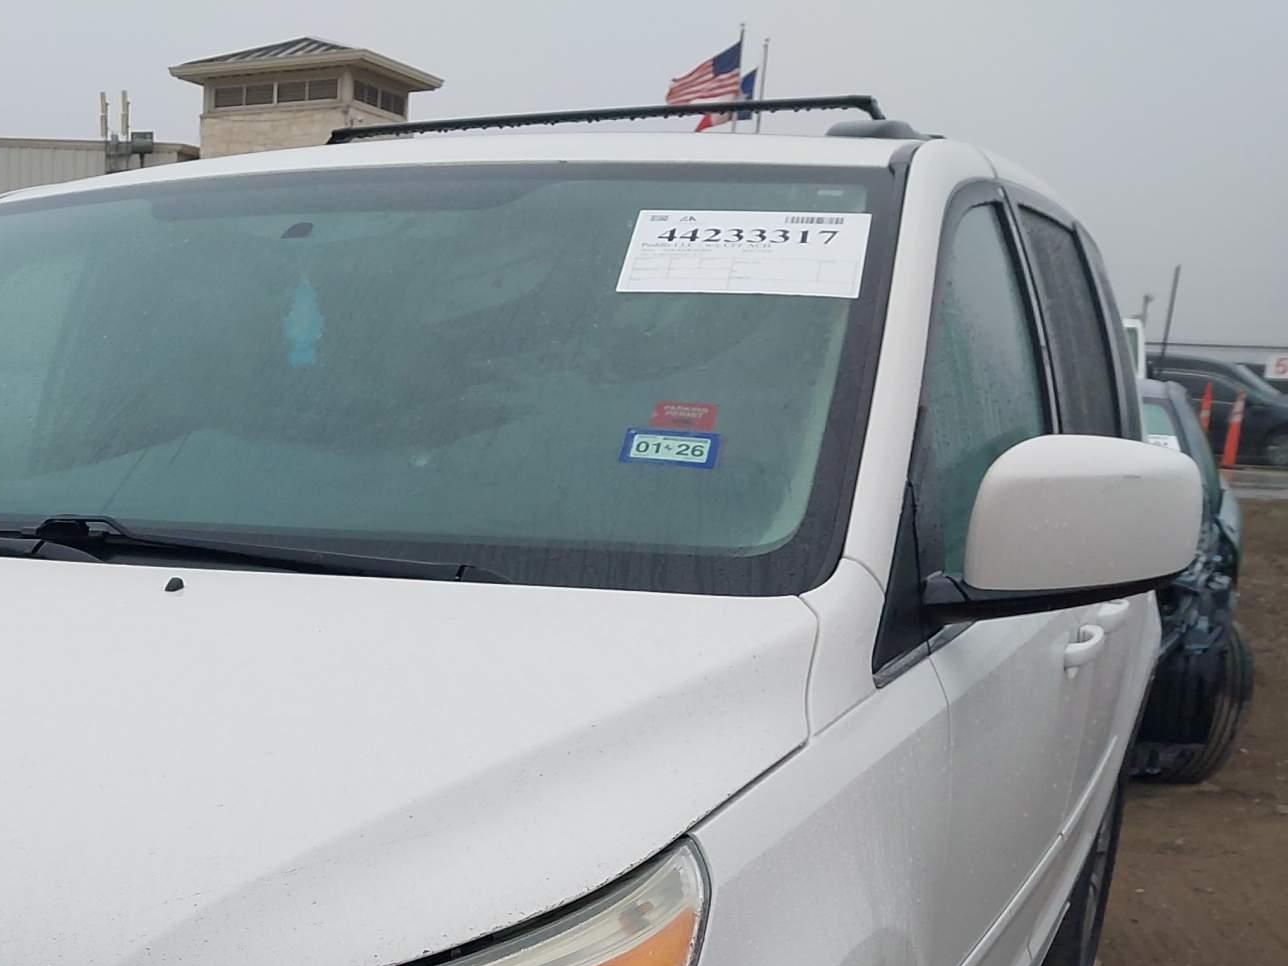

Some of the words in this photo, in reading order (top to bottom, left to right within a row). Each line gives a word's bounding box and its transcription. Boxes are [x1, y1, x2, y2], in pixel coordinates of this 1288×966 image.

[657, 228, 839, 245] 44233317
[635, 441, 662, 455] 01
[675, 443, 705, 457] 26
